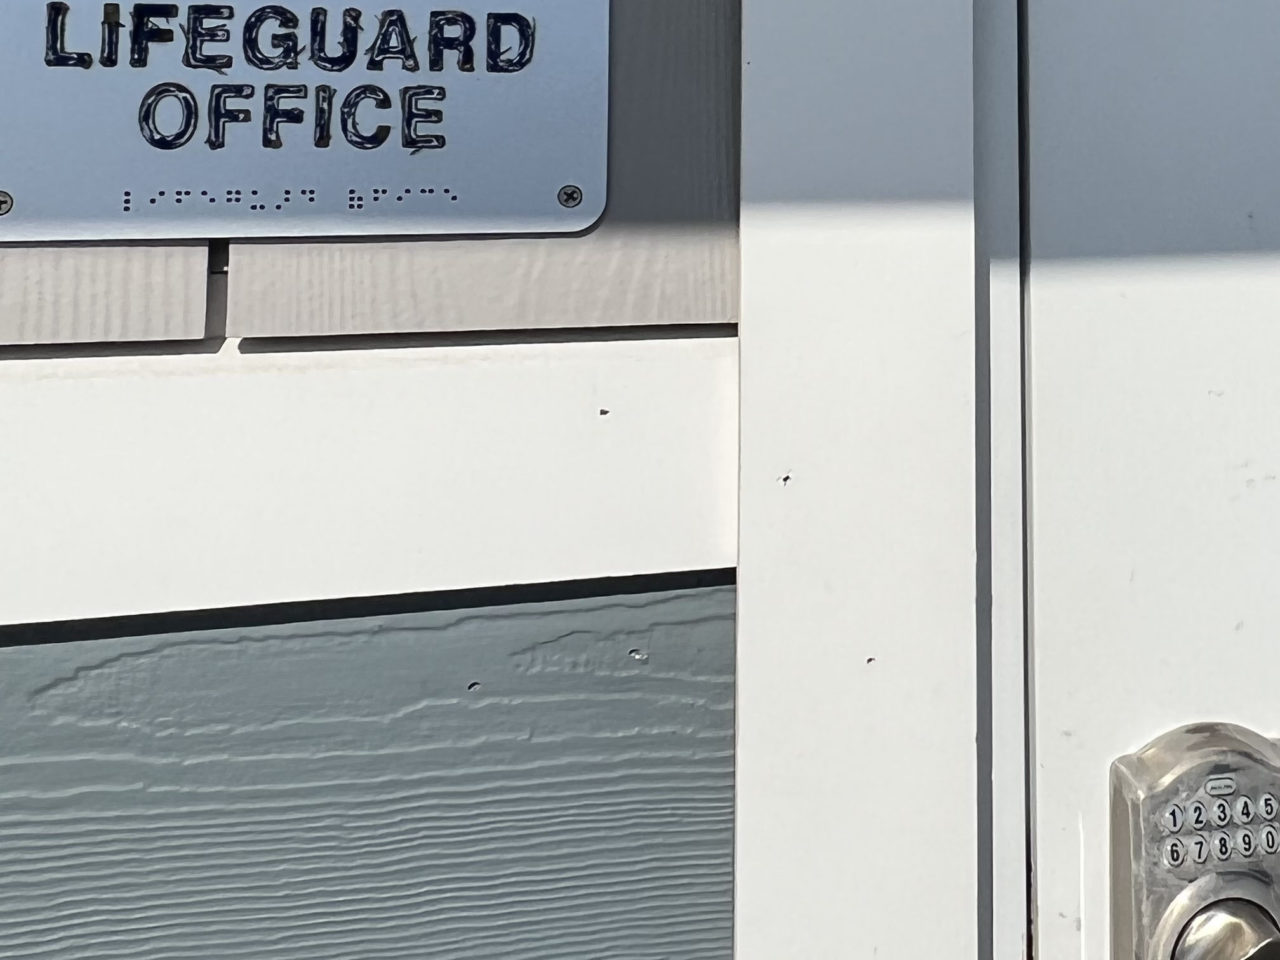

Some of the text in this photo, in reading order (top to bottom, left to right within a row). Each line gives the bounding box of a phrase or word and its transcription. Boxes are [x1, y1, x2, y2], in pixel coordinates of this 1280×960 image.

[45, 1, 536, 74] LIFEGUARD
[138, 81, 446, 151] OFFICE
[1169, 798, 1273, 827] 1 2 3 4 5
[1170, 831, 1275, 861] 6 7 8 9 0
